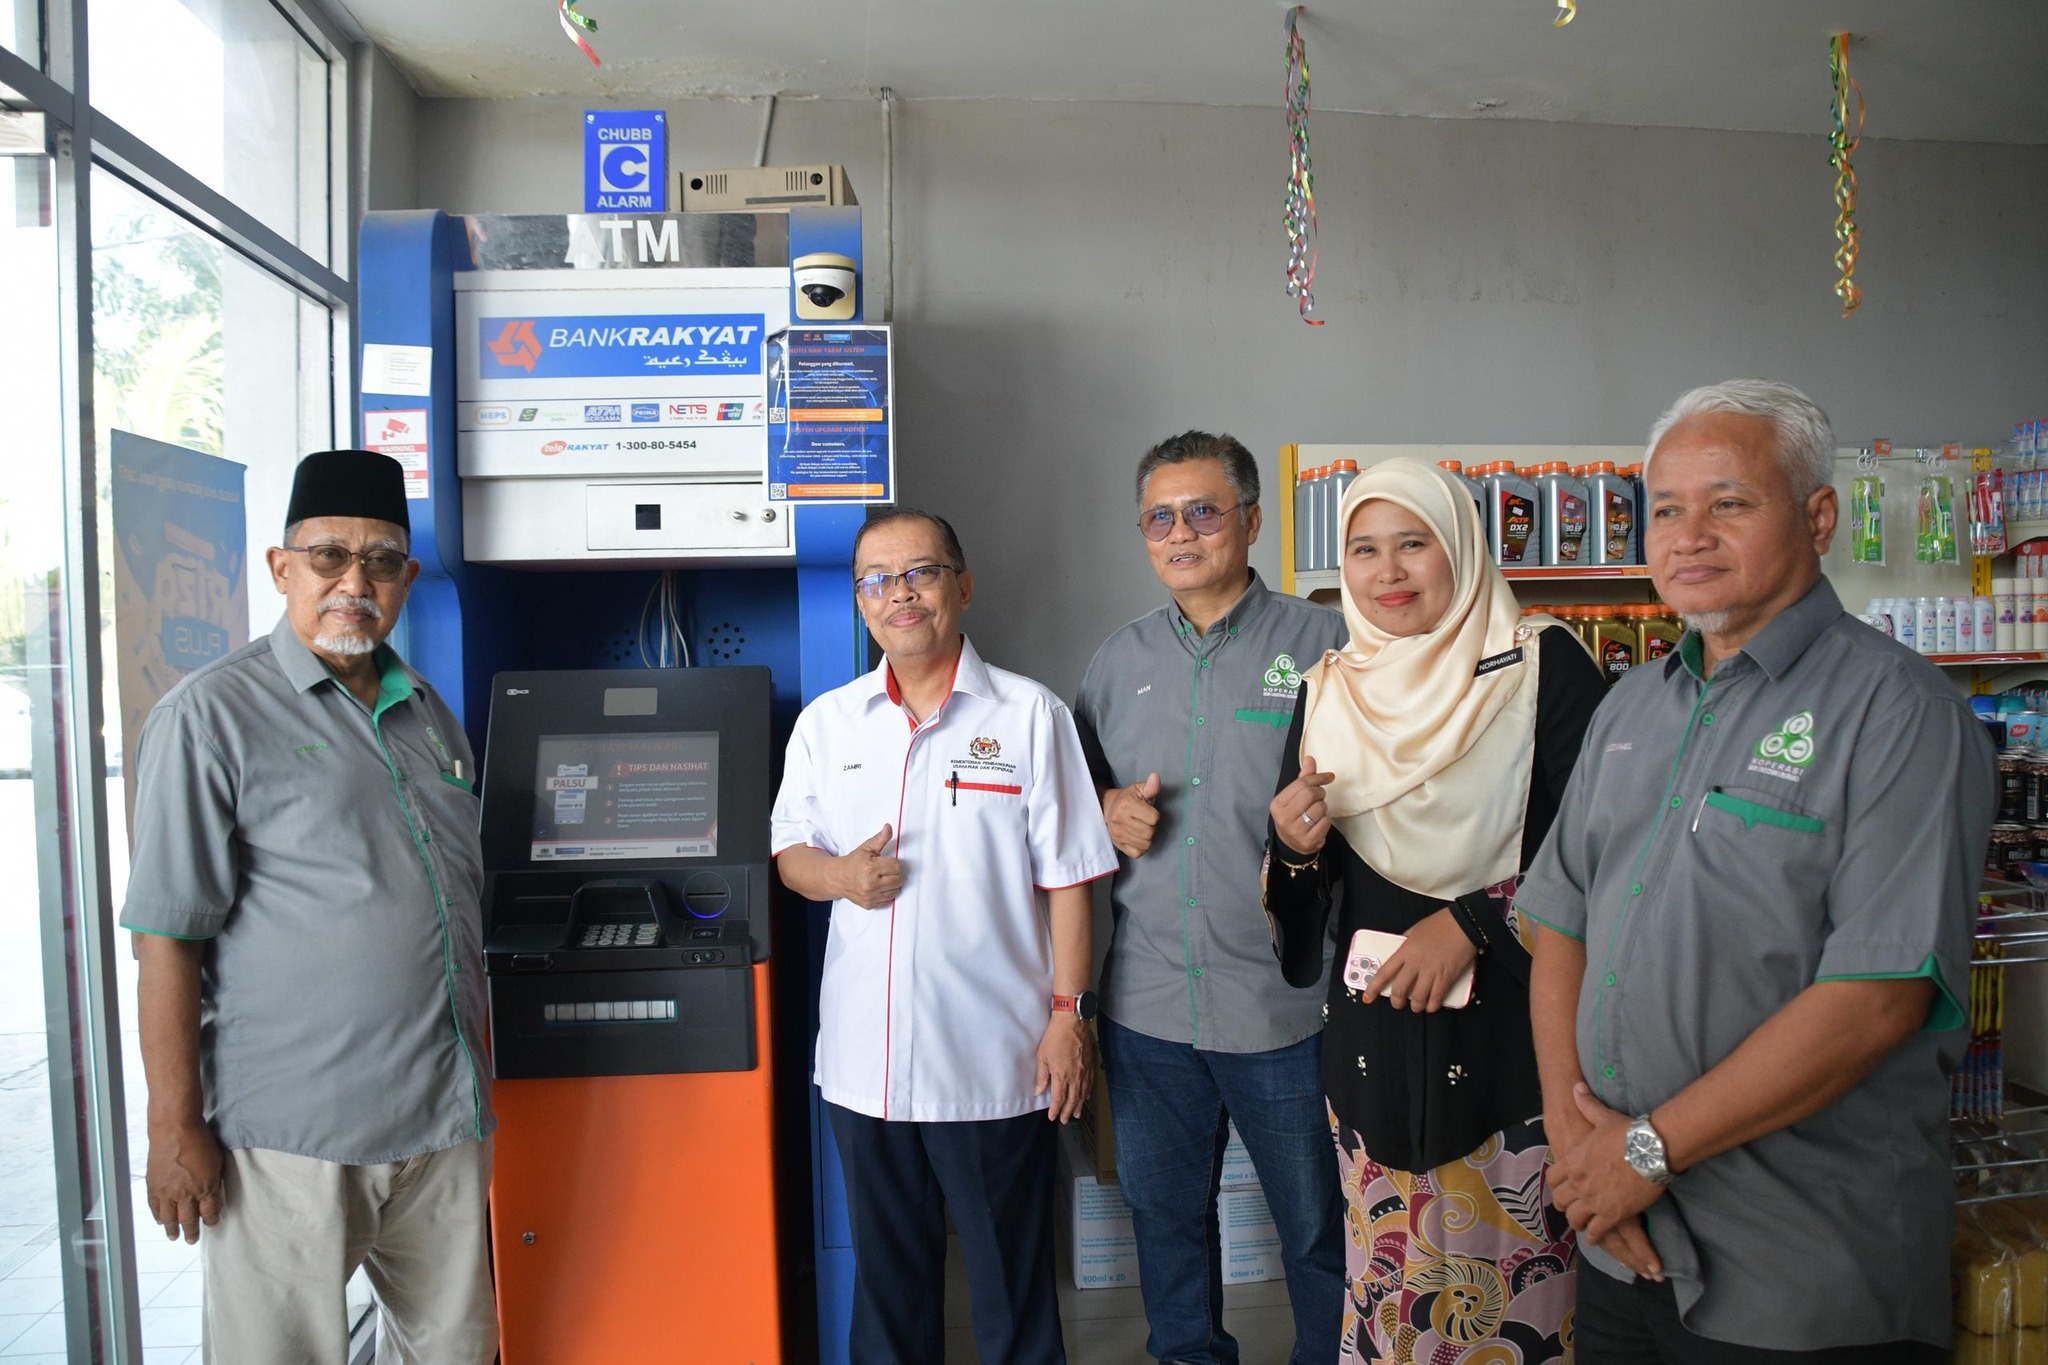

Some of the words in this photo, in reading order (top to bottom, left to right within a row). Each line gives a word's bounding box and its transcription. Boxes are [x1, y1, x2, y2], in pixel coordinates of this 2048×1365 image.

[597, 128, 653, 141] CHUBB
[603, 146, 648, 190] C
[597, 195, 652, 208] ALARM
[564, 219, 680, 263] ATM
[549, 325, 758, 348] BANKRAKYAT
[669, 405, 708, 415] NETS
[567, 443, 609, 451] RAKYAT
[616, 440, 697, 450] 1-300-80-5454
[1478, 653, 1517, 672] NORHAYATI
[1609, 663, 1629, 671] 800
[1137, 685, 1151, 695] MAN
[1263, 687, 1299, 695] KOPERAS
[629, 764, 648, 772] TIPS
[649, 763, 669, 771] DAN
[670, 762, 709, 771] NASIHAT
[553, 778, 587, 788] PALSU
[1082, 1275, 1107, 1283] 800ml
[1230, 1270, 1249, 1278] 425ml
